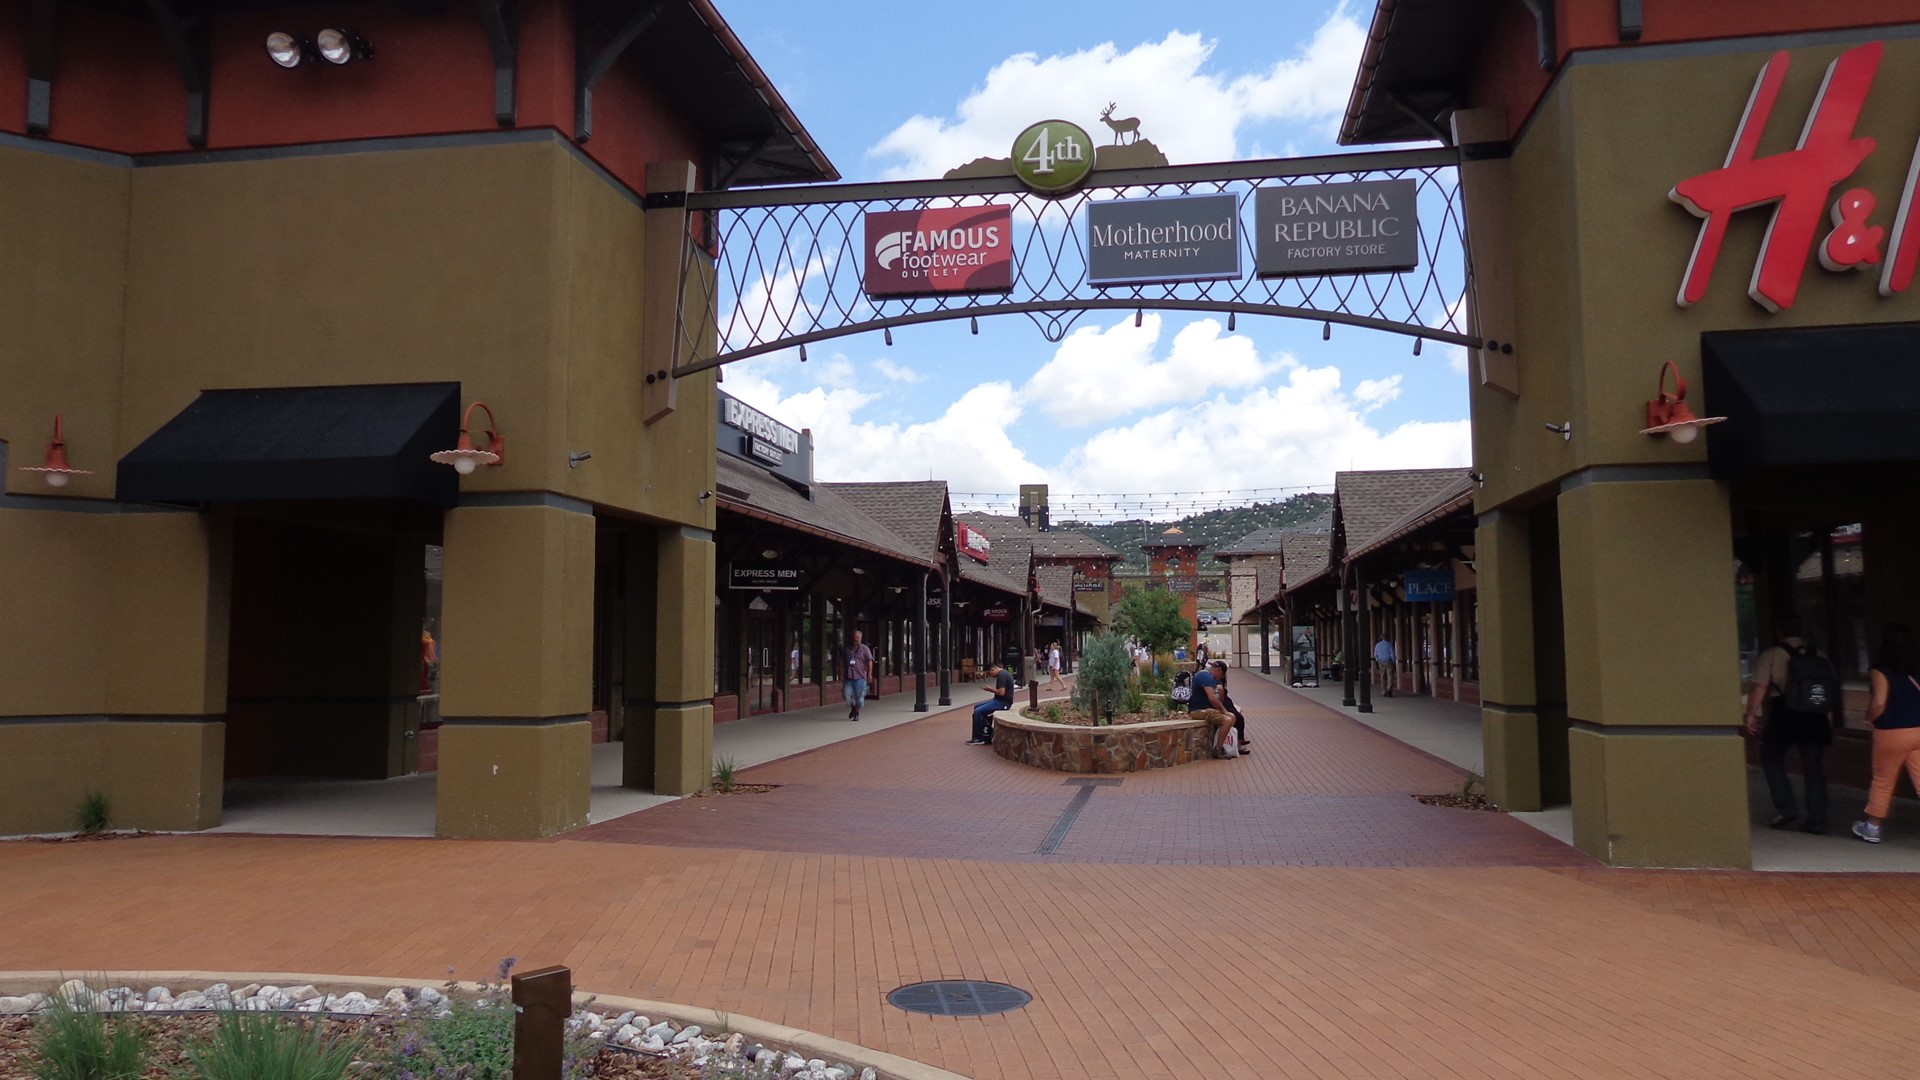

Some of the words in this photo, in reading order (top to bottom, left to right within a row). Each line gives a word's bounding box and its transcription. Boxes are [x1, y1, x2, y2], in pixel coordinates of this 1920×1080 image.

[1023, 127, 1083, 175] 4th
[1669, 41, 1920, 314] H&
[1281, 193, 1391, 217] BANANA
[901, 227, 999, 252] FAMOUS
[1092, 217, 1233, 247] Motherhood
[1274, 217, 1399, 243] REPUBLIC
[902, 252, 988, 269] footwear
[1124, 248, 1201, 260] MATERNITY
[1287, 246, 1342, 259] FACTORY
[1345, 243, 1387, 256] STORE
[901, 268, 959, 278] OUTLET
[725, 398, 778, 444] EXPRESS
[779, 425, 798, 454] MEN
[734, 569, 775, 578] EXPRESS
[777, 570, 797, 578] MEN
[1408, 582, 1453, 594] PLACE
